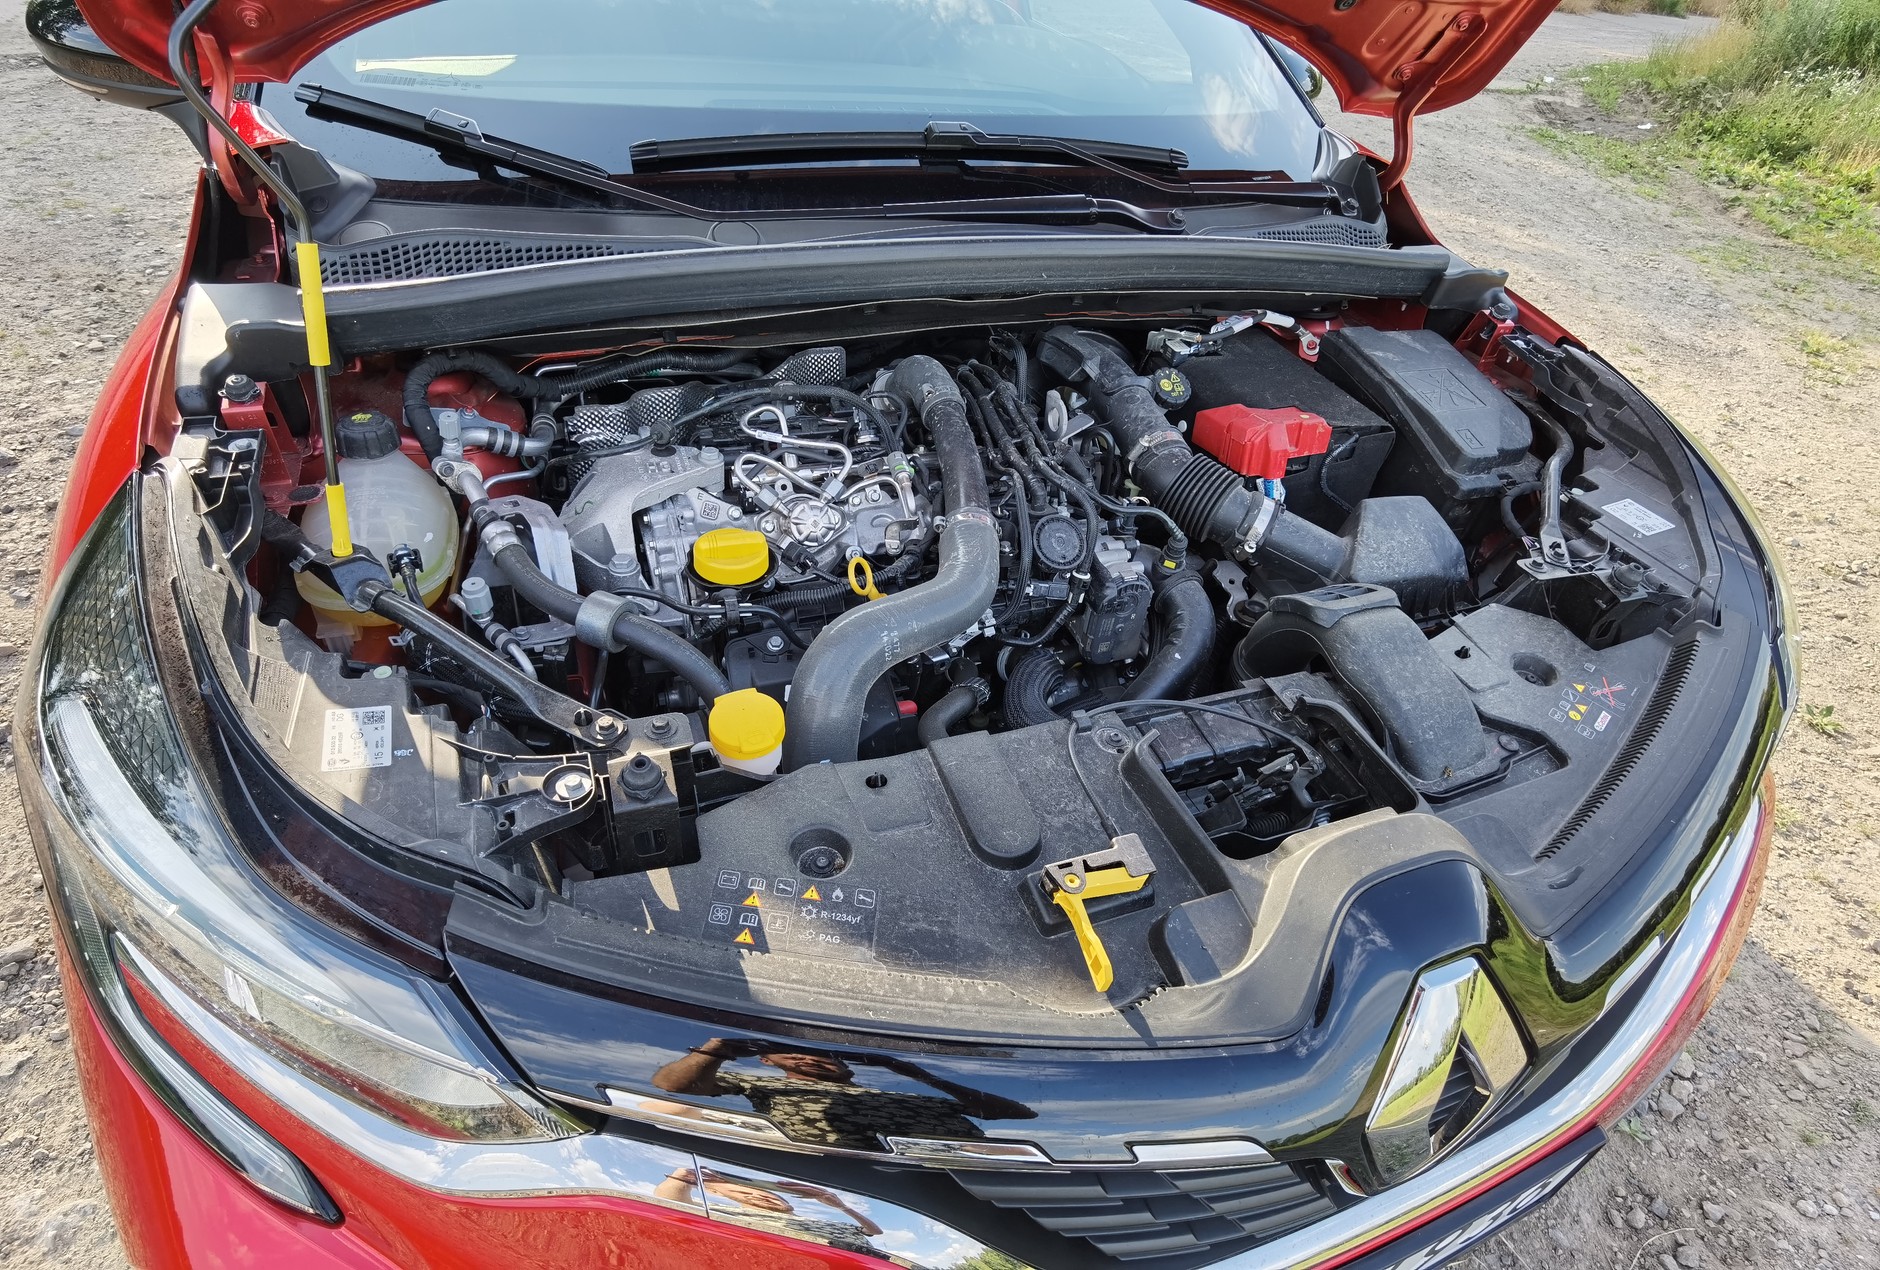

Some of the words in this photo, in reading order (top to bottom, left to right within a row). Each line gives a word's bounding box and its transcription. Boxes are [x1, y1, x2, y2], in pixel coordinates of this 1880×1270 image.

[374, 751, 384, 760] 15
[820, 910, 861, 925] R-1234yf
[819, 933, 841, 944] PAG
